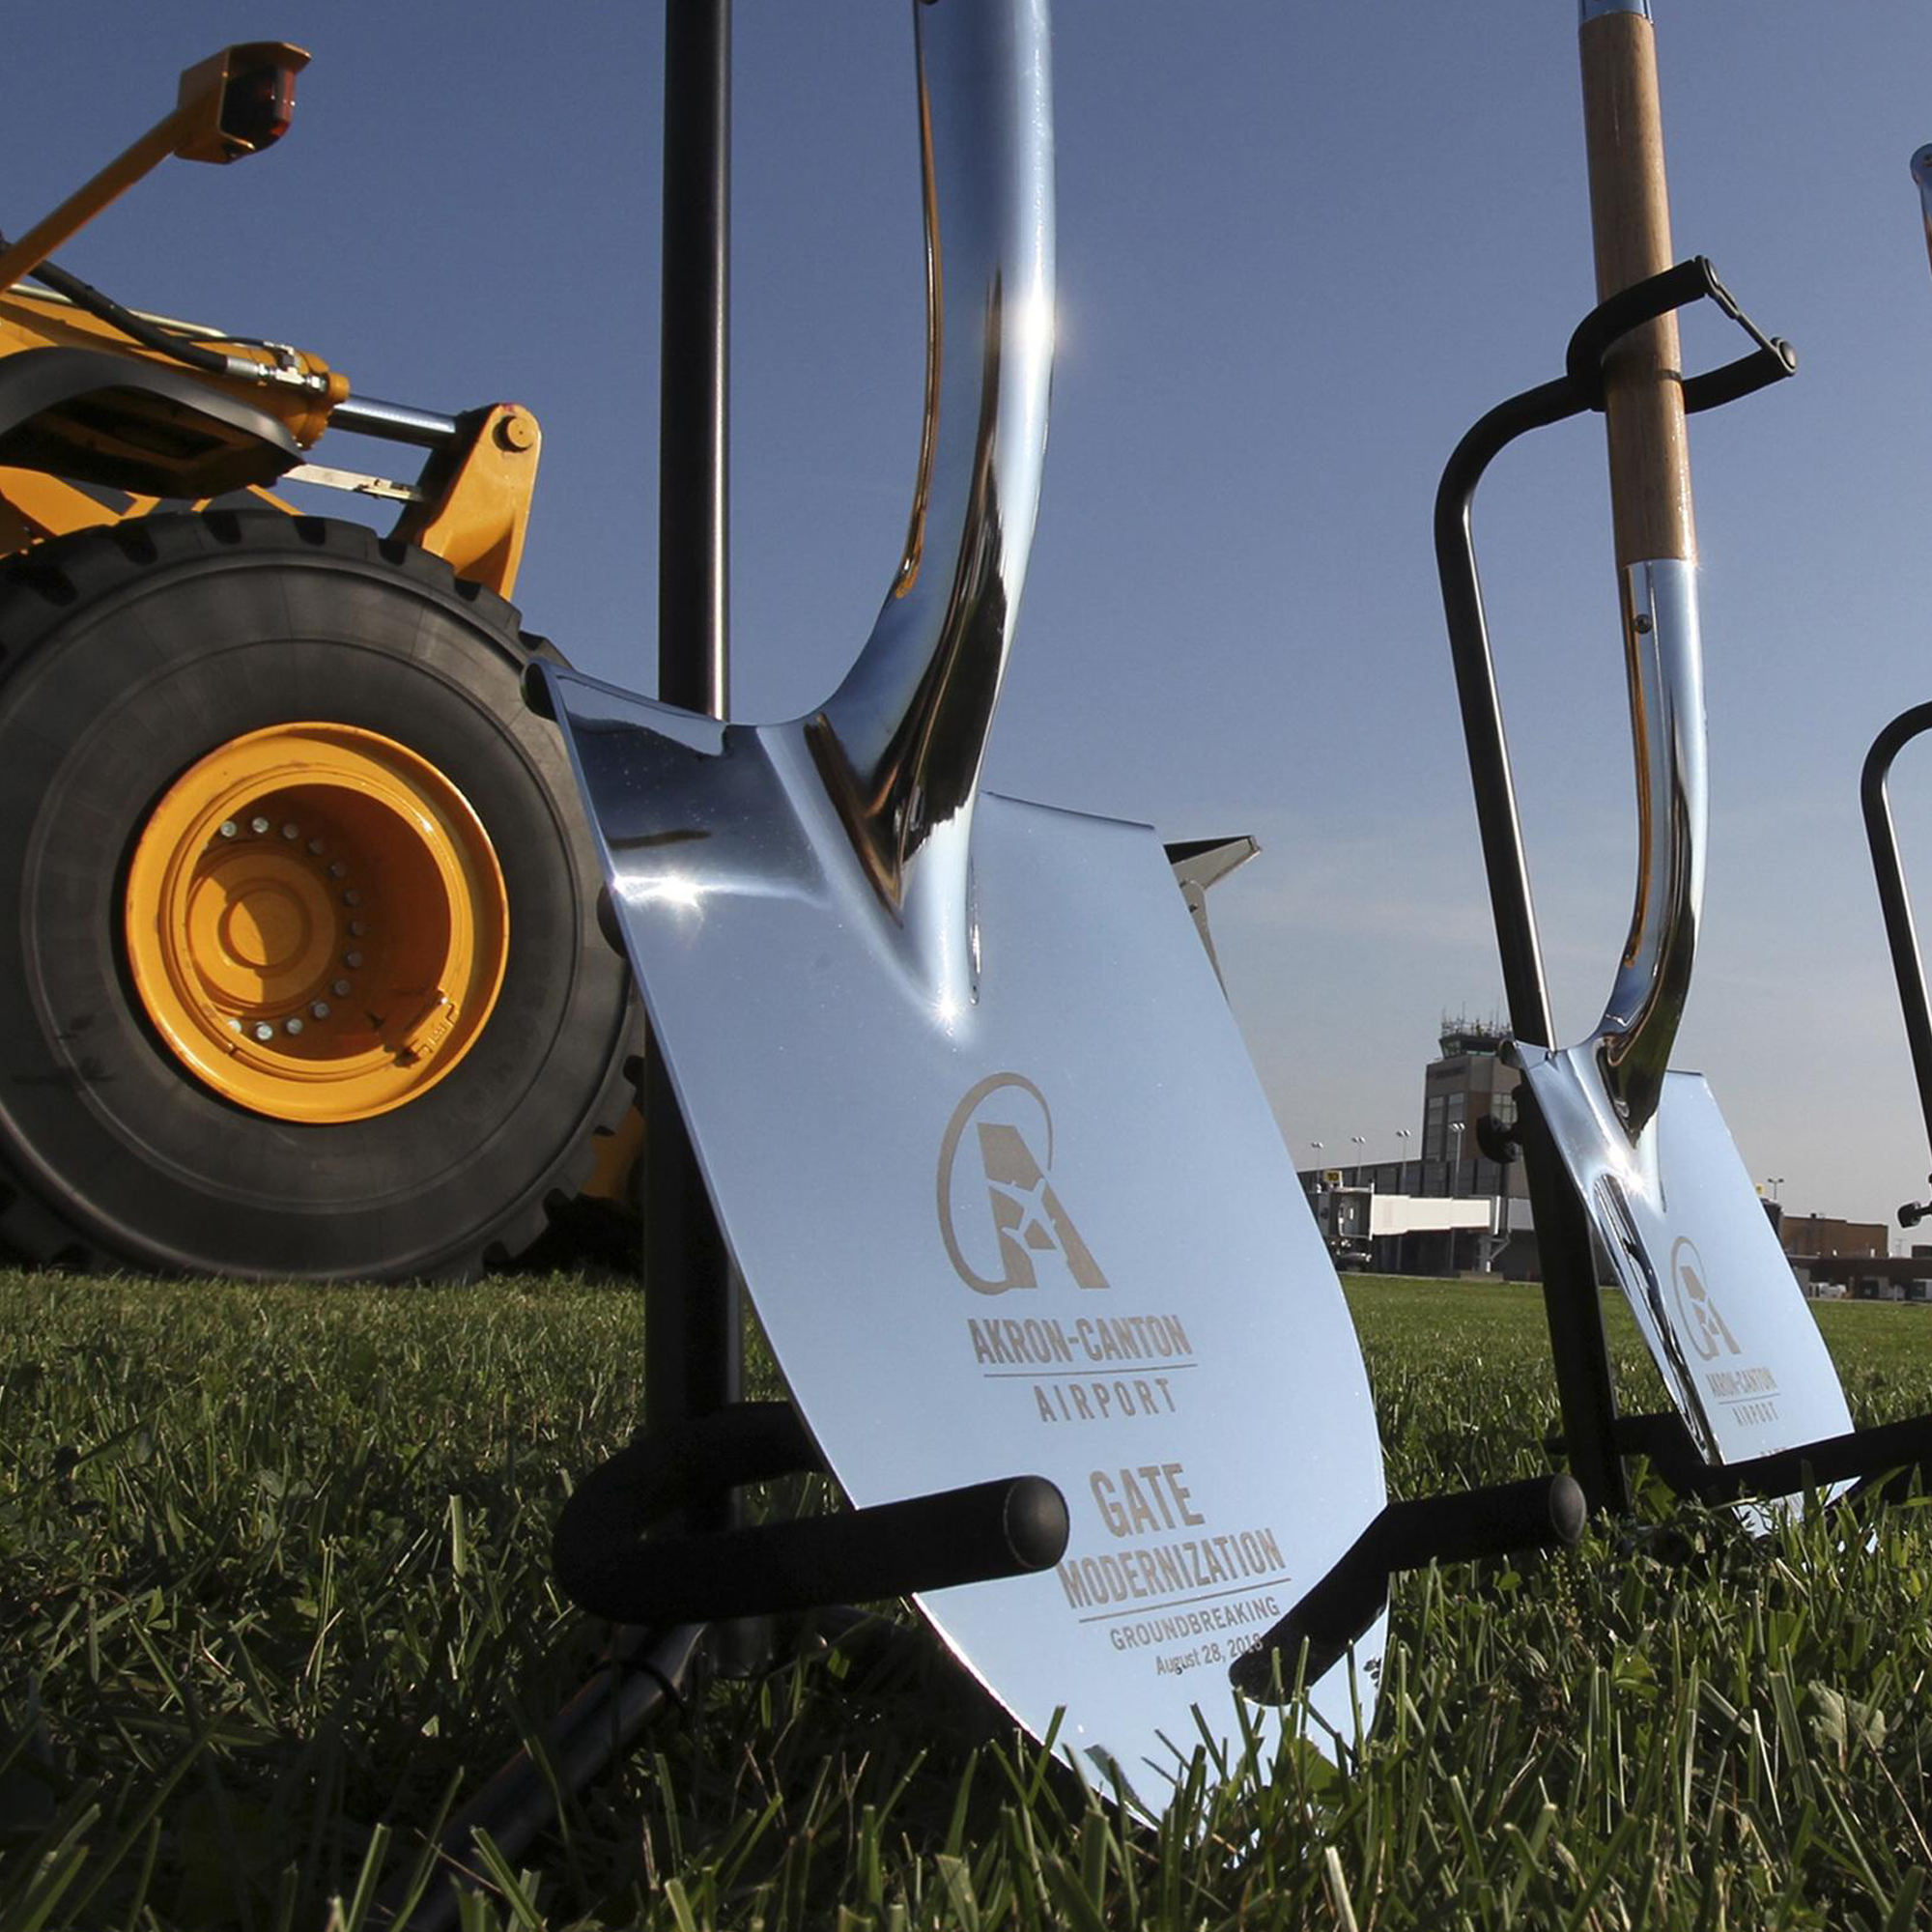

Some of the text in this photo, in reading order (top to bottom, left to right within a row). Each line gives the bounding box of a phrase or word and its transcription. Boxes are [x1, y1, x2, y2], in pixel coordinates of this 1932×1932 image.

[968, 1315, 1193, 1364] AKRON-CANTON
[1034, 1378, 1177, 1422] AIRPORT
[1089, 1463, 1206, 1538] GATE
[1056, 1528, 1287, 1609] MODERNIZATION
[1110, 1596, 1281, 1651] GROUNDBREAKING
[1155, 1648, 1201, 1676] August
[1202, 1643, 1226, 1663] 28,
